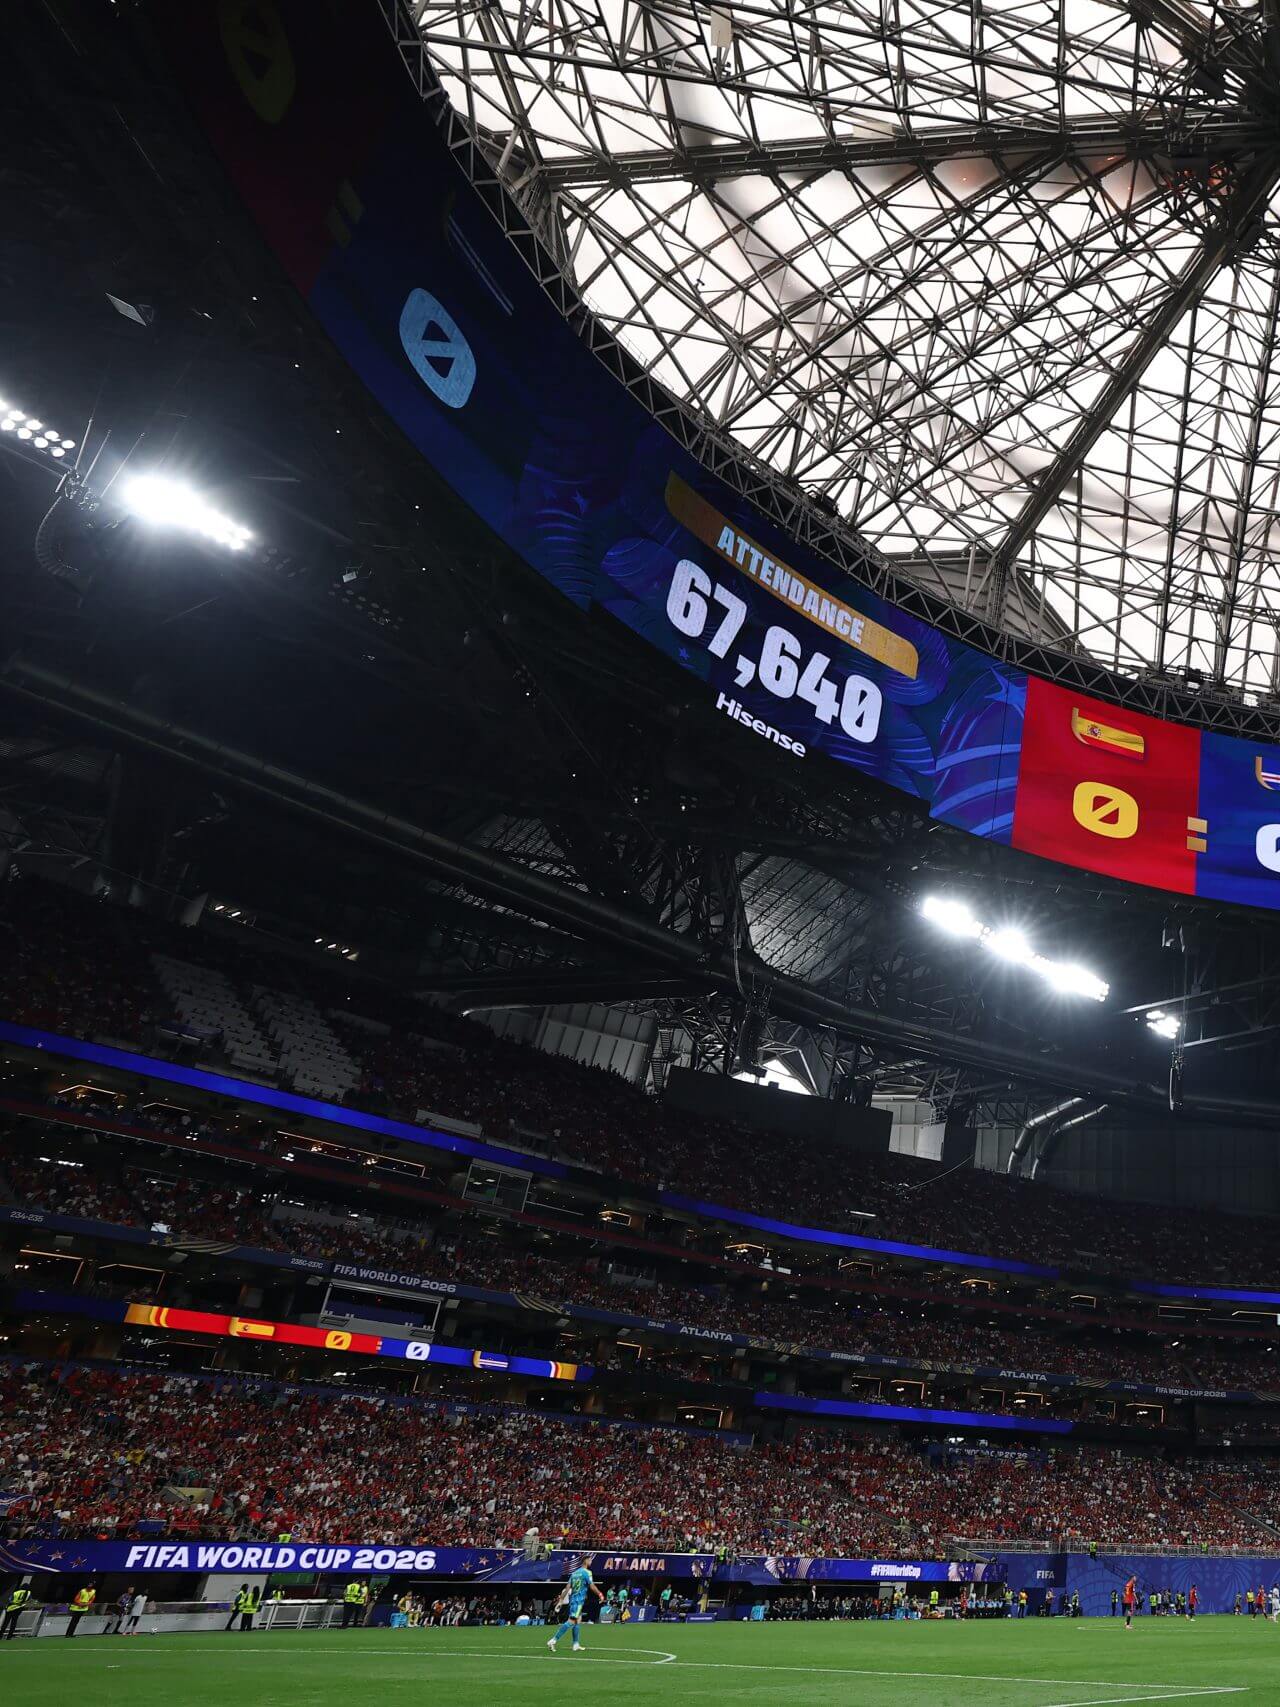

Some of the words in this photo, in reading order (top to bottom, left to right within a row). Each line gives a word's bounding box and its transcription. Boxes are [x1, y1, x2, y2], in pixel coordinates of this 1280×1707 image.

[399, 287, 477, 408] 0
[717, 526, 865, 644] ATTENDANCE
[667, 559, 882, 743] 67,640
[716, 692, 806, 757] Hisense
[1073, 781, 1139, 839] 0
[333, 1263, 358, 1277] FIFA
[359, 1268, 399, 1283] WORLD
[399, 1274, 421, 1287] CUP
[420, 1279, 457, 1293] 2026
[325, 1330, 352, 1351] 0
[405, 1341, 431, 1361] 0
[680, 1325, 734, 1342] ATLANTA
[999, 1370, 1048, 1382] ATLANTA
[1155, 1386, 1168, 1395] FIFA
[1168, 1388, 1190, 1397] WORLD
[1190, 1390, 1203, 1398] CUP
[1203, 1390, 1228, 1399] 2026
[126, 1546, 191, 1569] FIFA
[197, 1547, 297, 1570] WORLD
[299, 1548, 353, 1570] CUP
[351, 1551, 436, 1570] 2026
[604, 1557, 666, 1571] ATLANTA
[871, 1563, 922, 1579] #FIFAWorldCup
[1036, 1569, 1056, 1579] FIFA
